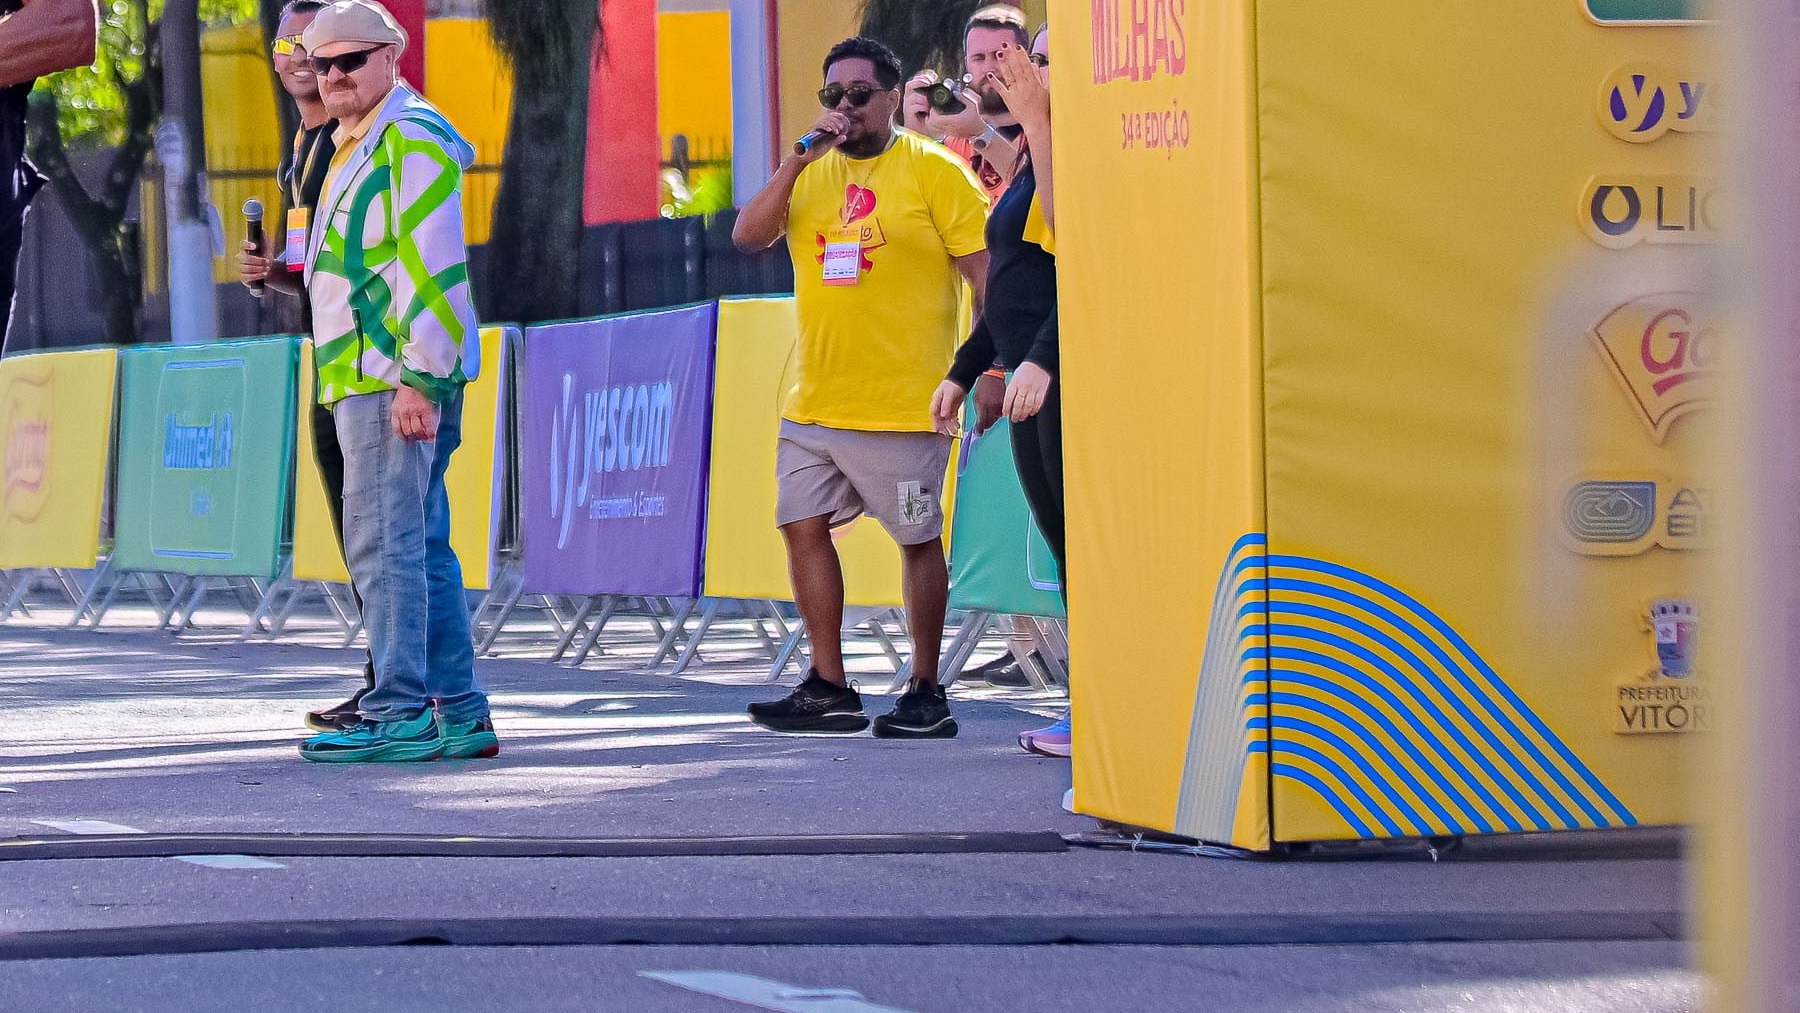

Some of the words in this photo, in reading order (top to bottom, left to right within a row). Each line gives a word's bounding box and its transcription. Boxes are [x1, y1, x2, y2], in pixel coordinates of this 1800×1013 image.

[1144, 99, 1190, 161] EDIÇÃO
[577, 381, 673, 508] yescom
[1618, 700, 1713, 730] VITÓR
